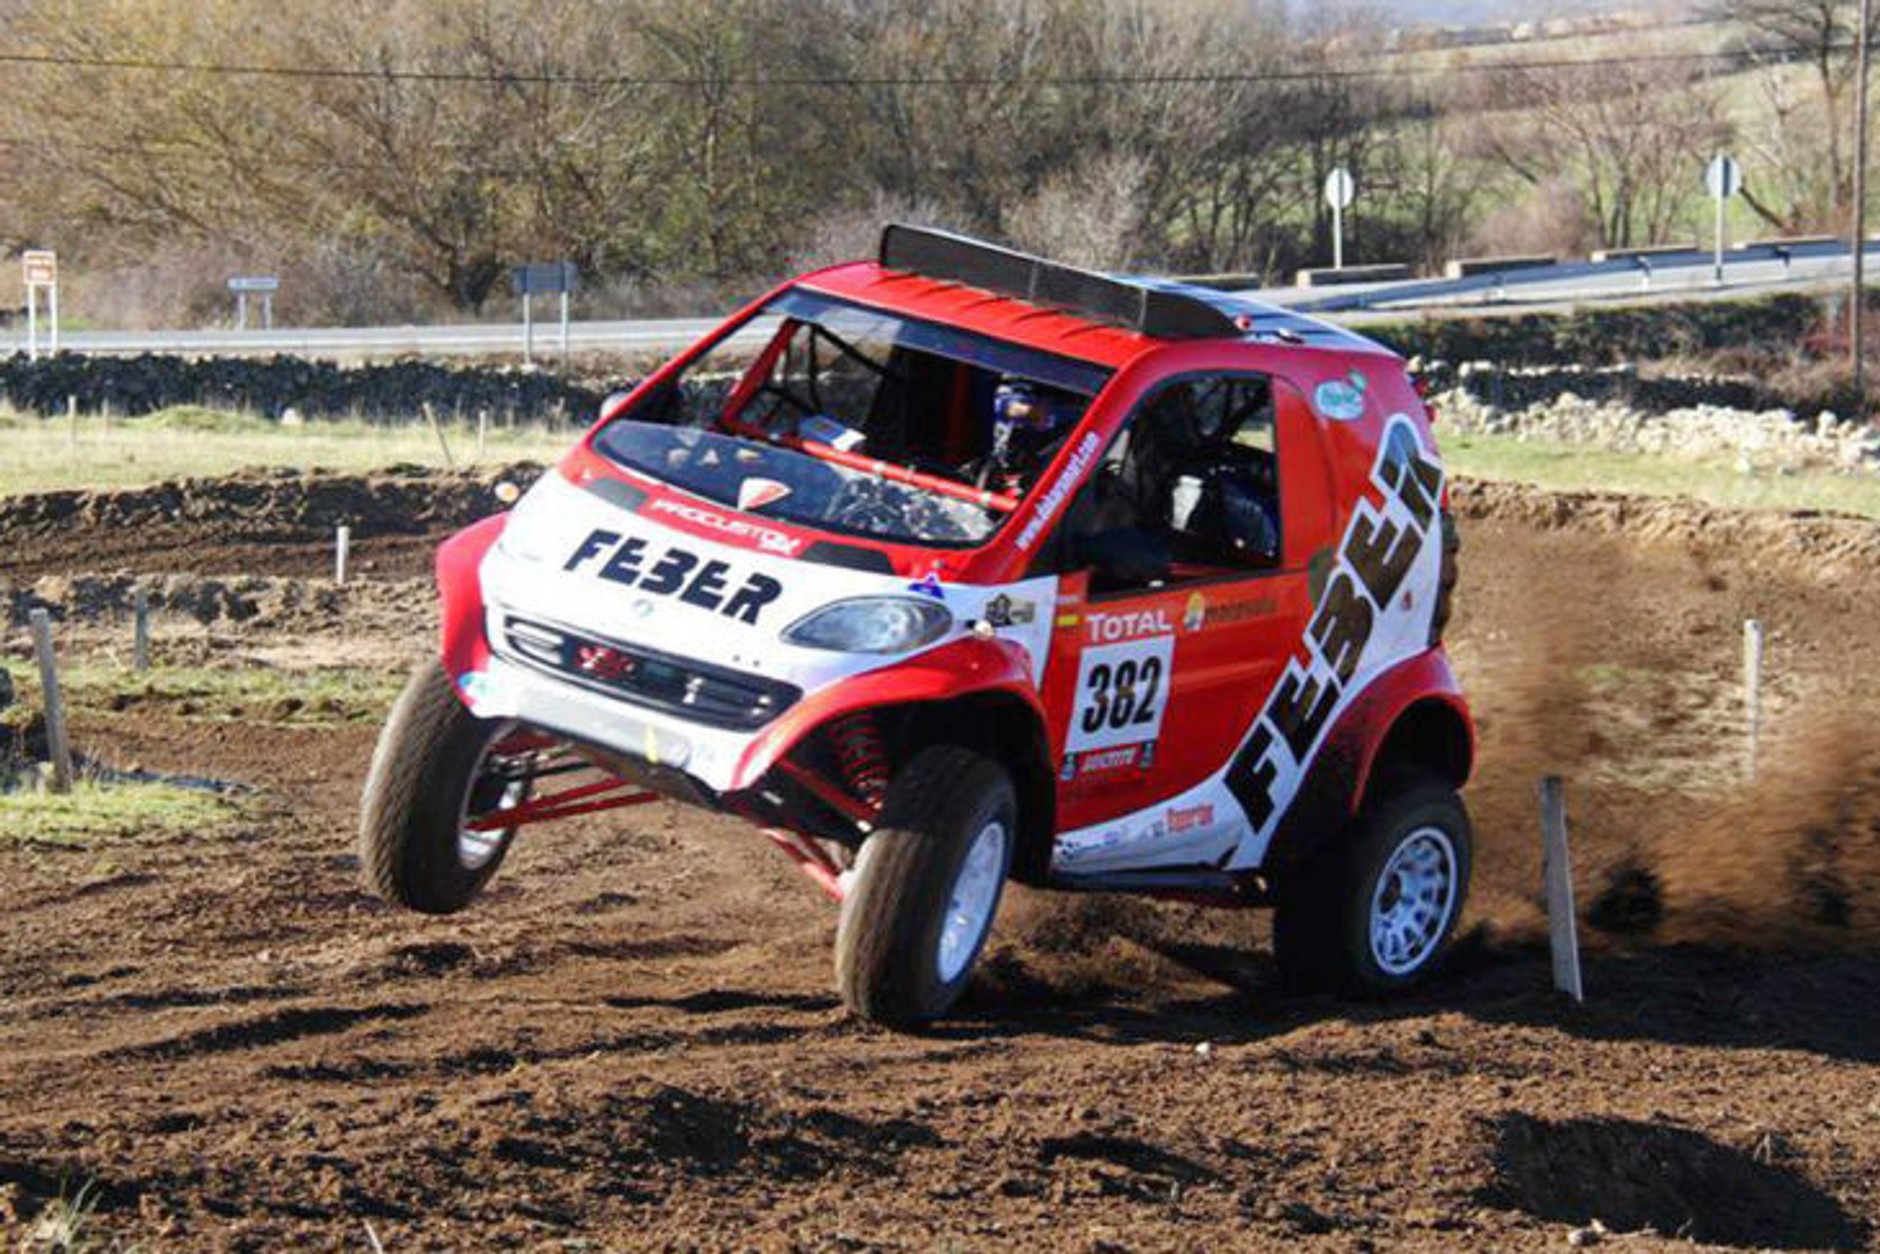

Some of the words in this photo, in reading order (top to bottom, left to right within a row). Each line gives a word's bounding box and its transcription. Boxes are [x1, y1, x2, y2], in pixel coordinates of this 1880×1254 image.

[562, 528, 783, 626] FEBER
[1085, 609, 1174, 643] TOTAL
[1082, 655, 1162, 734] 382
